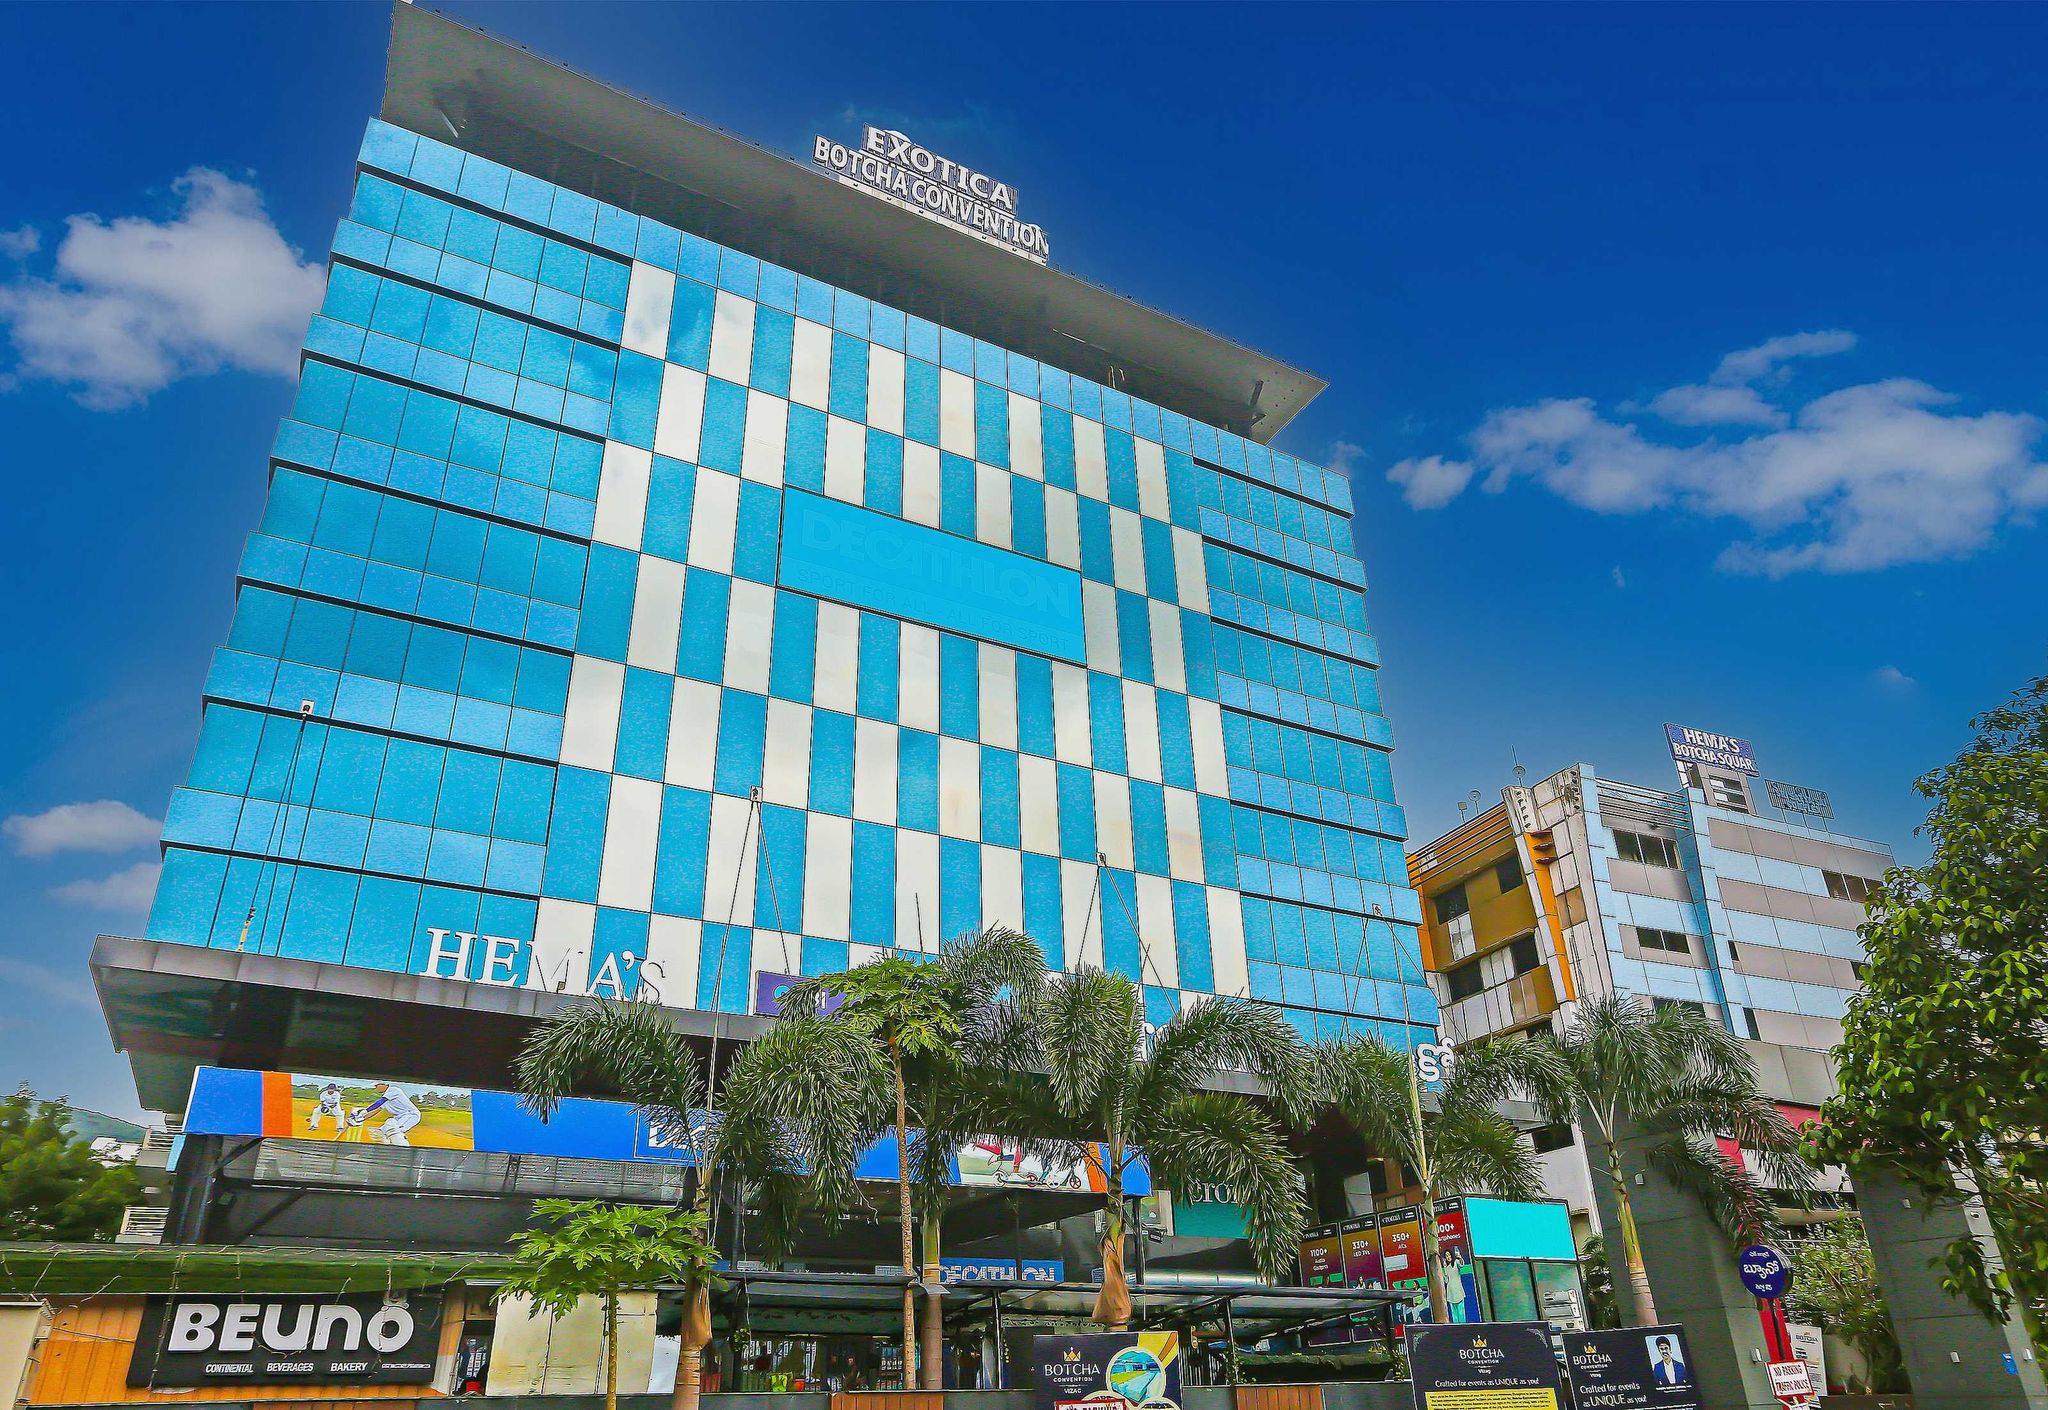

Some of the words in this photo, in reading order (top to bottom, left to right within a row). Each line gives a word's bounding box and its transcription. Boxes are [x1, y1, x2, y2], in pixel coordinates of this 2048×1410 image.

[867, 126, 1013, 210] EXOTICA
[814, 135, 908, 198] BOTCHA
[911, 179, 1048, 255] CONVENTION
[1683, 728, 1741, 753] HEMA'S
[1673, 742, 1718, 763] BOTCHA
[419, 927, 666, 1005] HEMA'S
[1459, 1349, 1505, 1359] BOTCHA
[1572, 1354, 1612, 1365] BOTCHA
[205, 1363, 254, 1373] CONTINENTAL
[266, 1362, 314, 1372] BEVERAGES
[330, 1361, 369, 1372] BAKERY
[1044, 1363, 1100, 1377] BOTCHA
[1435, 1379, 1458, 1387] Crafted
[1495, 1378, 1518, 1386] UNIQUE
[1580, 1384, 1606, 1394] Crafted
[1607, 1383, 1617, 1392] for
[1618, 1382, 1640, 1391] events
[1590, 1394, 1626, 1407] UNIQUE
